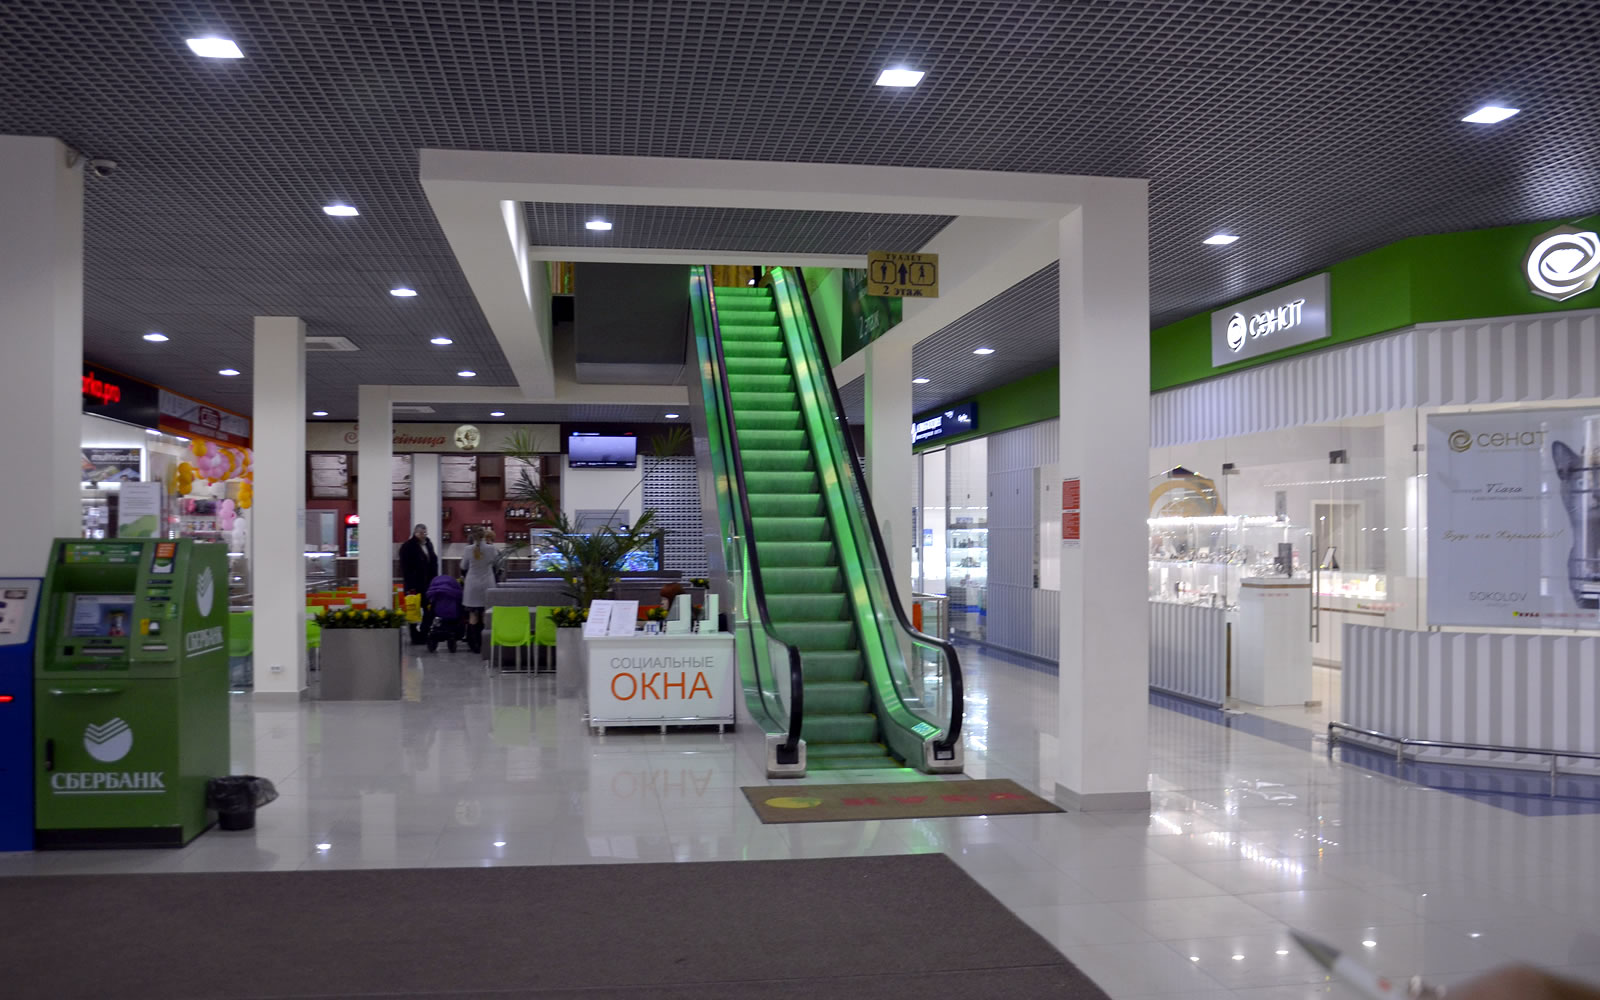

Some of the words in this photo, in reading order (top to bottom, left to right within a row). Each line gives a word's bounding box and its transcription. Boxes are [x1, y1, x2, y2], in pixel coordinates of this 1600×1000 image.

[886, 254, 923, 262] ТУАЛЕТ
[883, 286, 890, 295] 2
[1470, 592, 1528, 601] SOKOLOV
[610, 656, 714, 671] СОЦИАЛЬНЫЕ
[611, 672, 713, 701] ОКНА
[51, 772, 166, 789] СБЕРБАНК
